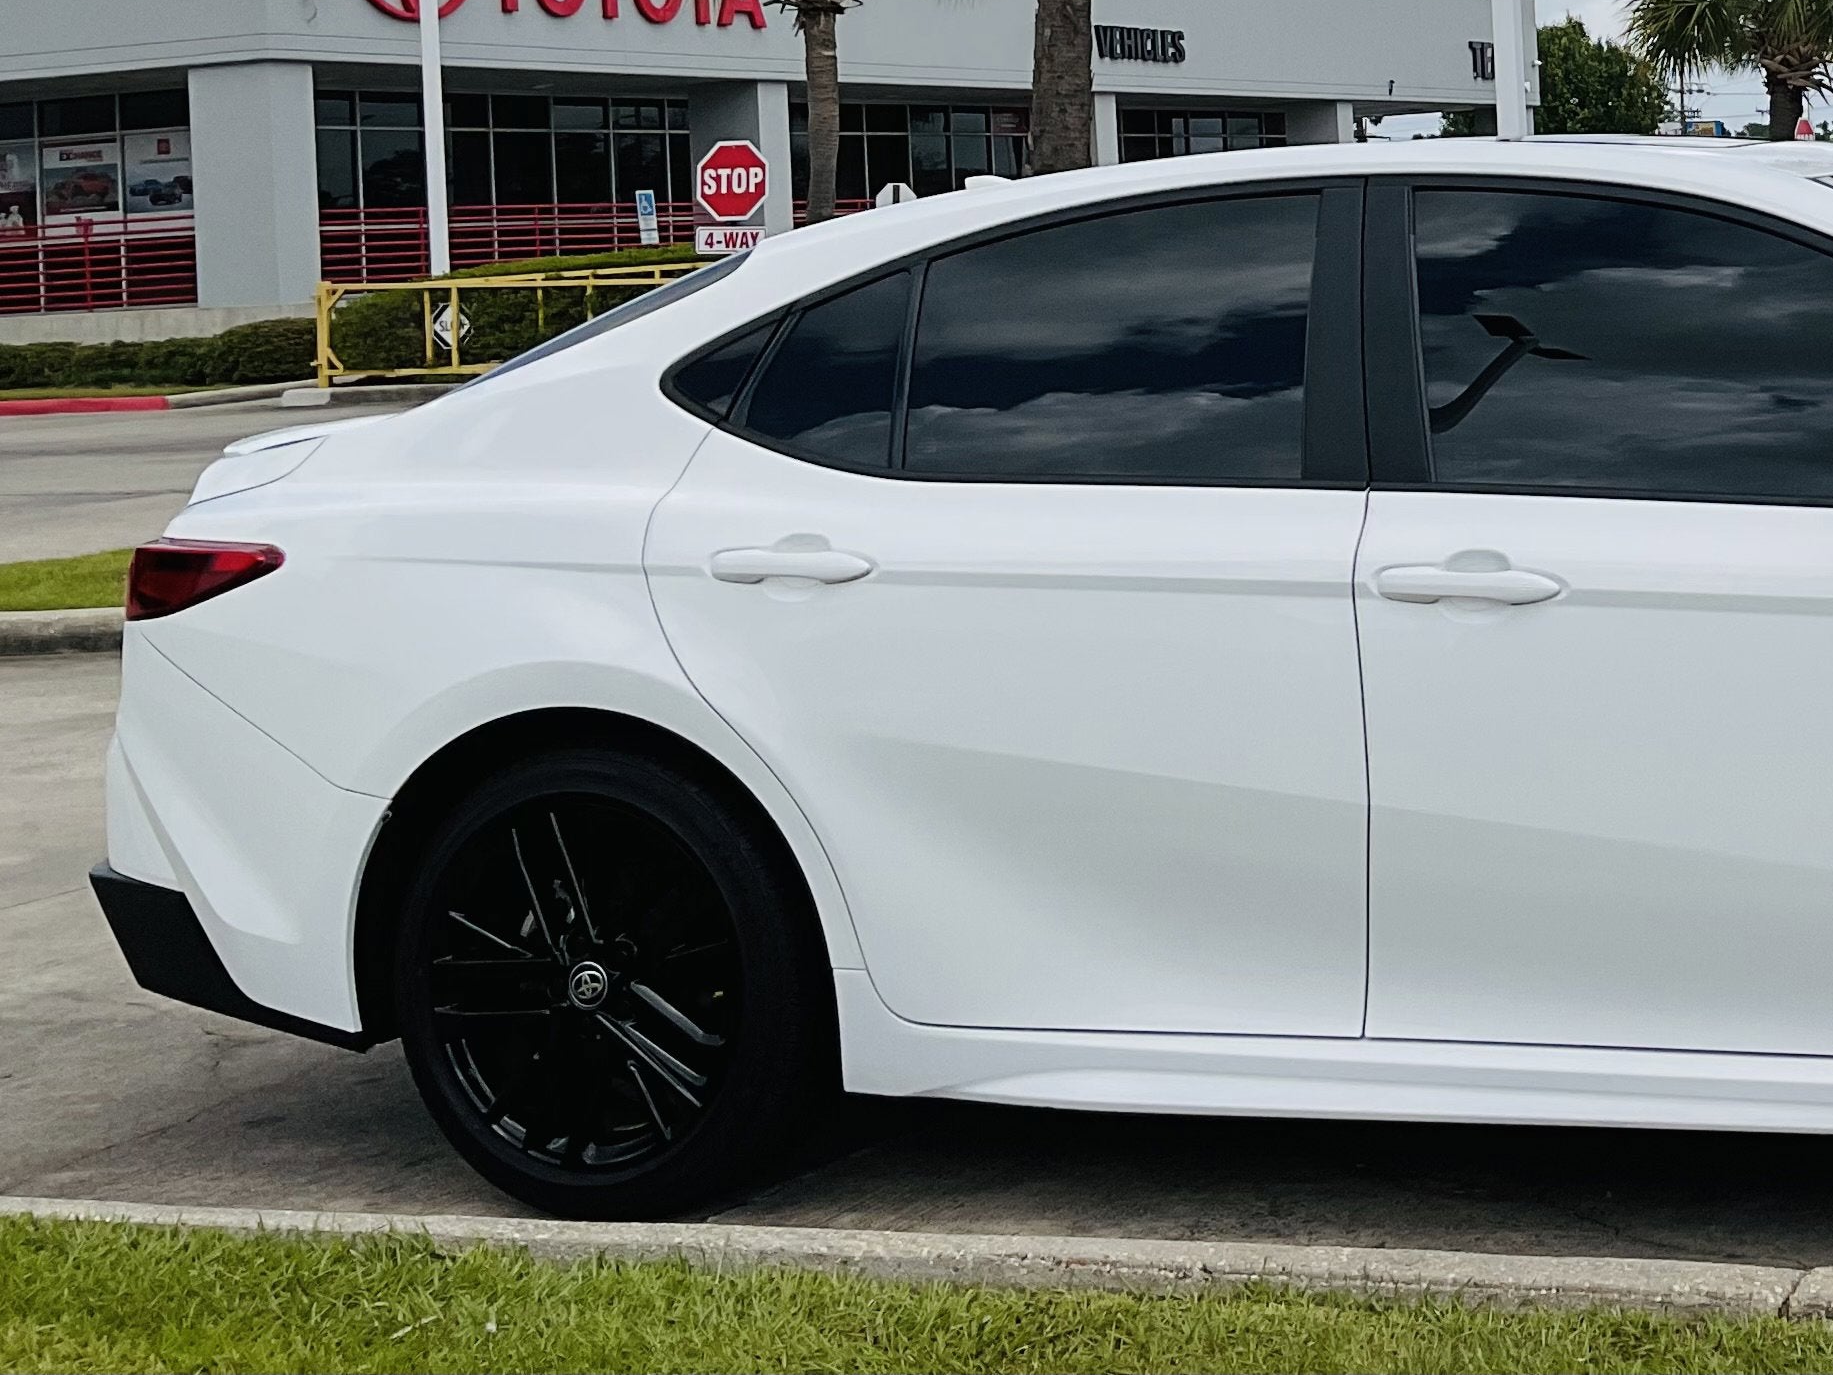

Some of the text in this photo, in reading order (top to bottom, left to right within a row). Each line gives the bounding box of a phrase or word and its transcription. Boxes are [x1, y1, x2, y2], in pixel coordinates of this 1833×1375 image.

[1094, 25, 1185, 63] VEHICLES
[703, 167, 764, 195] STOP
[704, 231, 760, 249] 4-WAY
